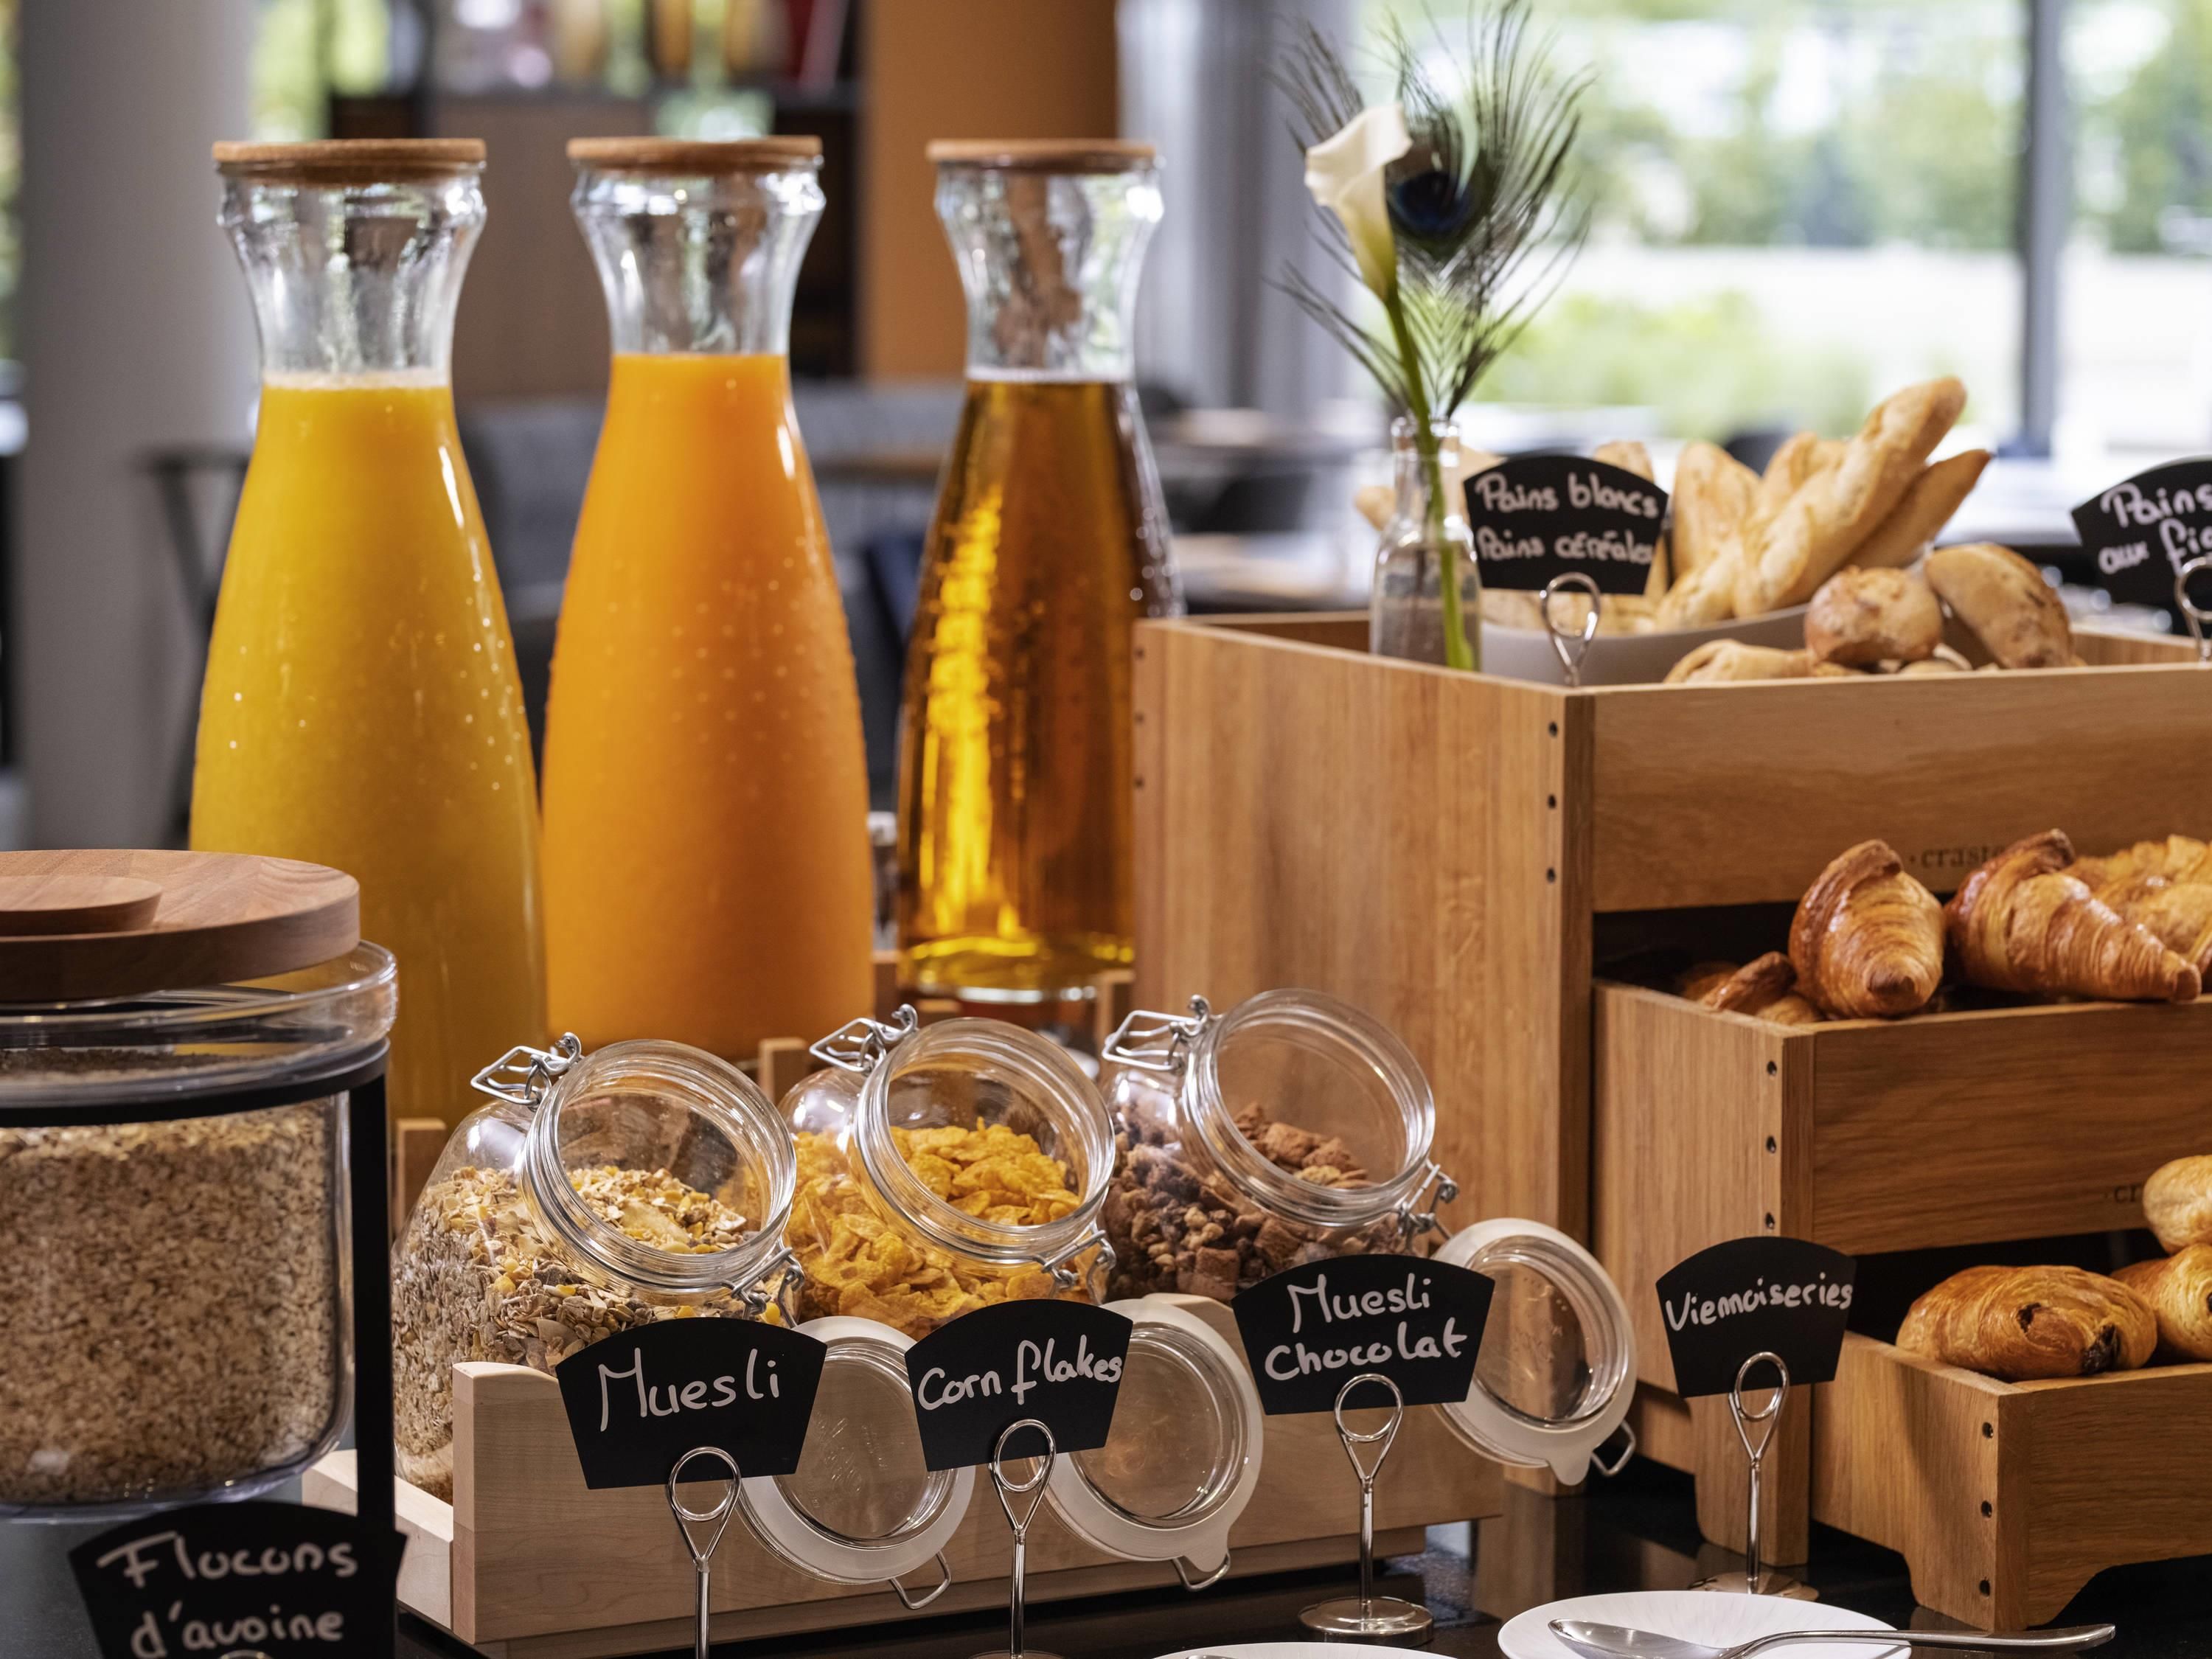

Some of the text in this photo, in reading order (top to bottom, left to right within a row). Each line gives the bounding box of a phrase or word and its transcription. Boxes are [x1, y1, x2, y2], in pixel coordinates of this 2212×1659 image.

[1475, 471, 1659, 518] Pains blancs
[2100, 481, 2212, 529] Pains
[1476, 525, 1545, 562] Pains
[1287, 1273, 1431, 1334] Muesli
[917, 1334, 1123, 1411] Corn flakes
[1265, 1316, 1468, 1381] Chocolat
[598, 1346, 780, 1433] Muesli
[97, 1531, 358, 1588] Flocons
[130, 1600, 344, 1659] d'avoine
